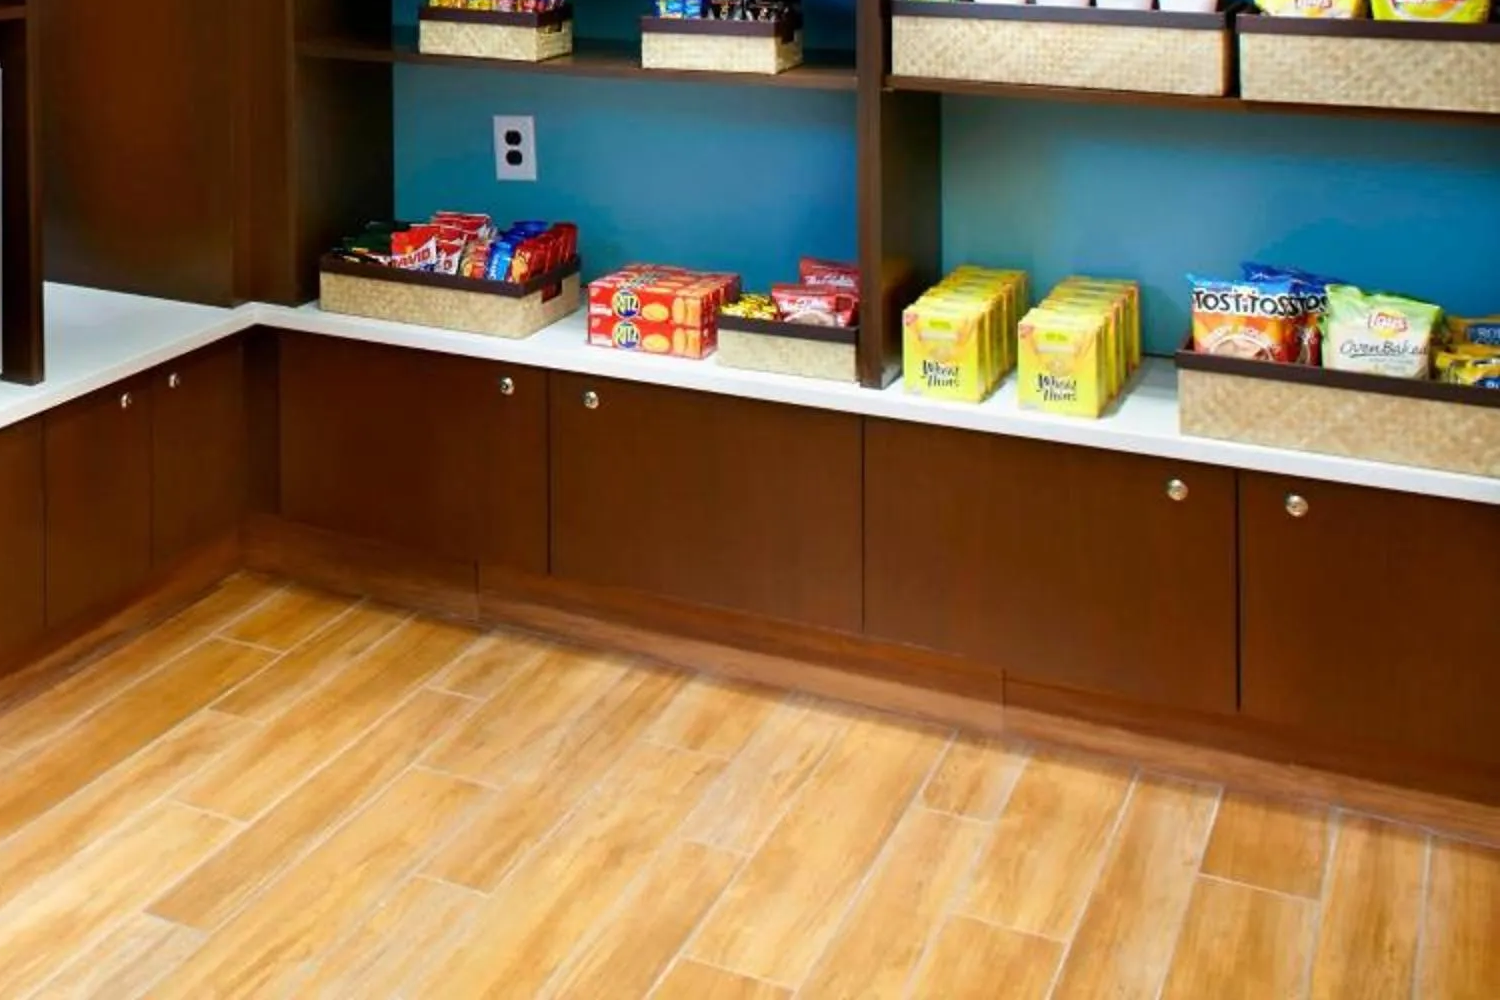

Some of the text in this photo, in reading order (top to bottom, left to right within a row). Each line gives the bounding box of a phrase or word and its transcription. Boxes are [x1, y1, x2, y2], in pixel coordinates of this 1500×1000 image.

[922, 359, 959, 376] Wheat
[921, 374, 961, 388] Thins
[1037, 373, 1077, 391] Wheat
[1036, 388, 1078, 402] Thins
